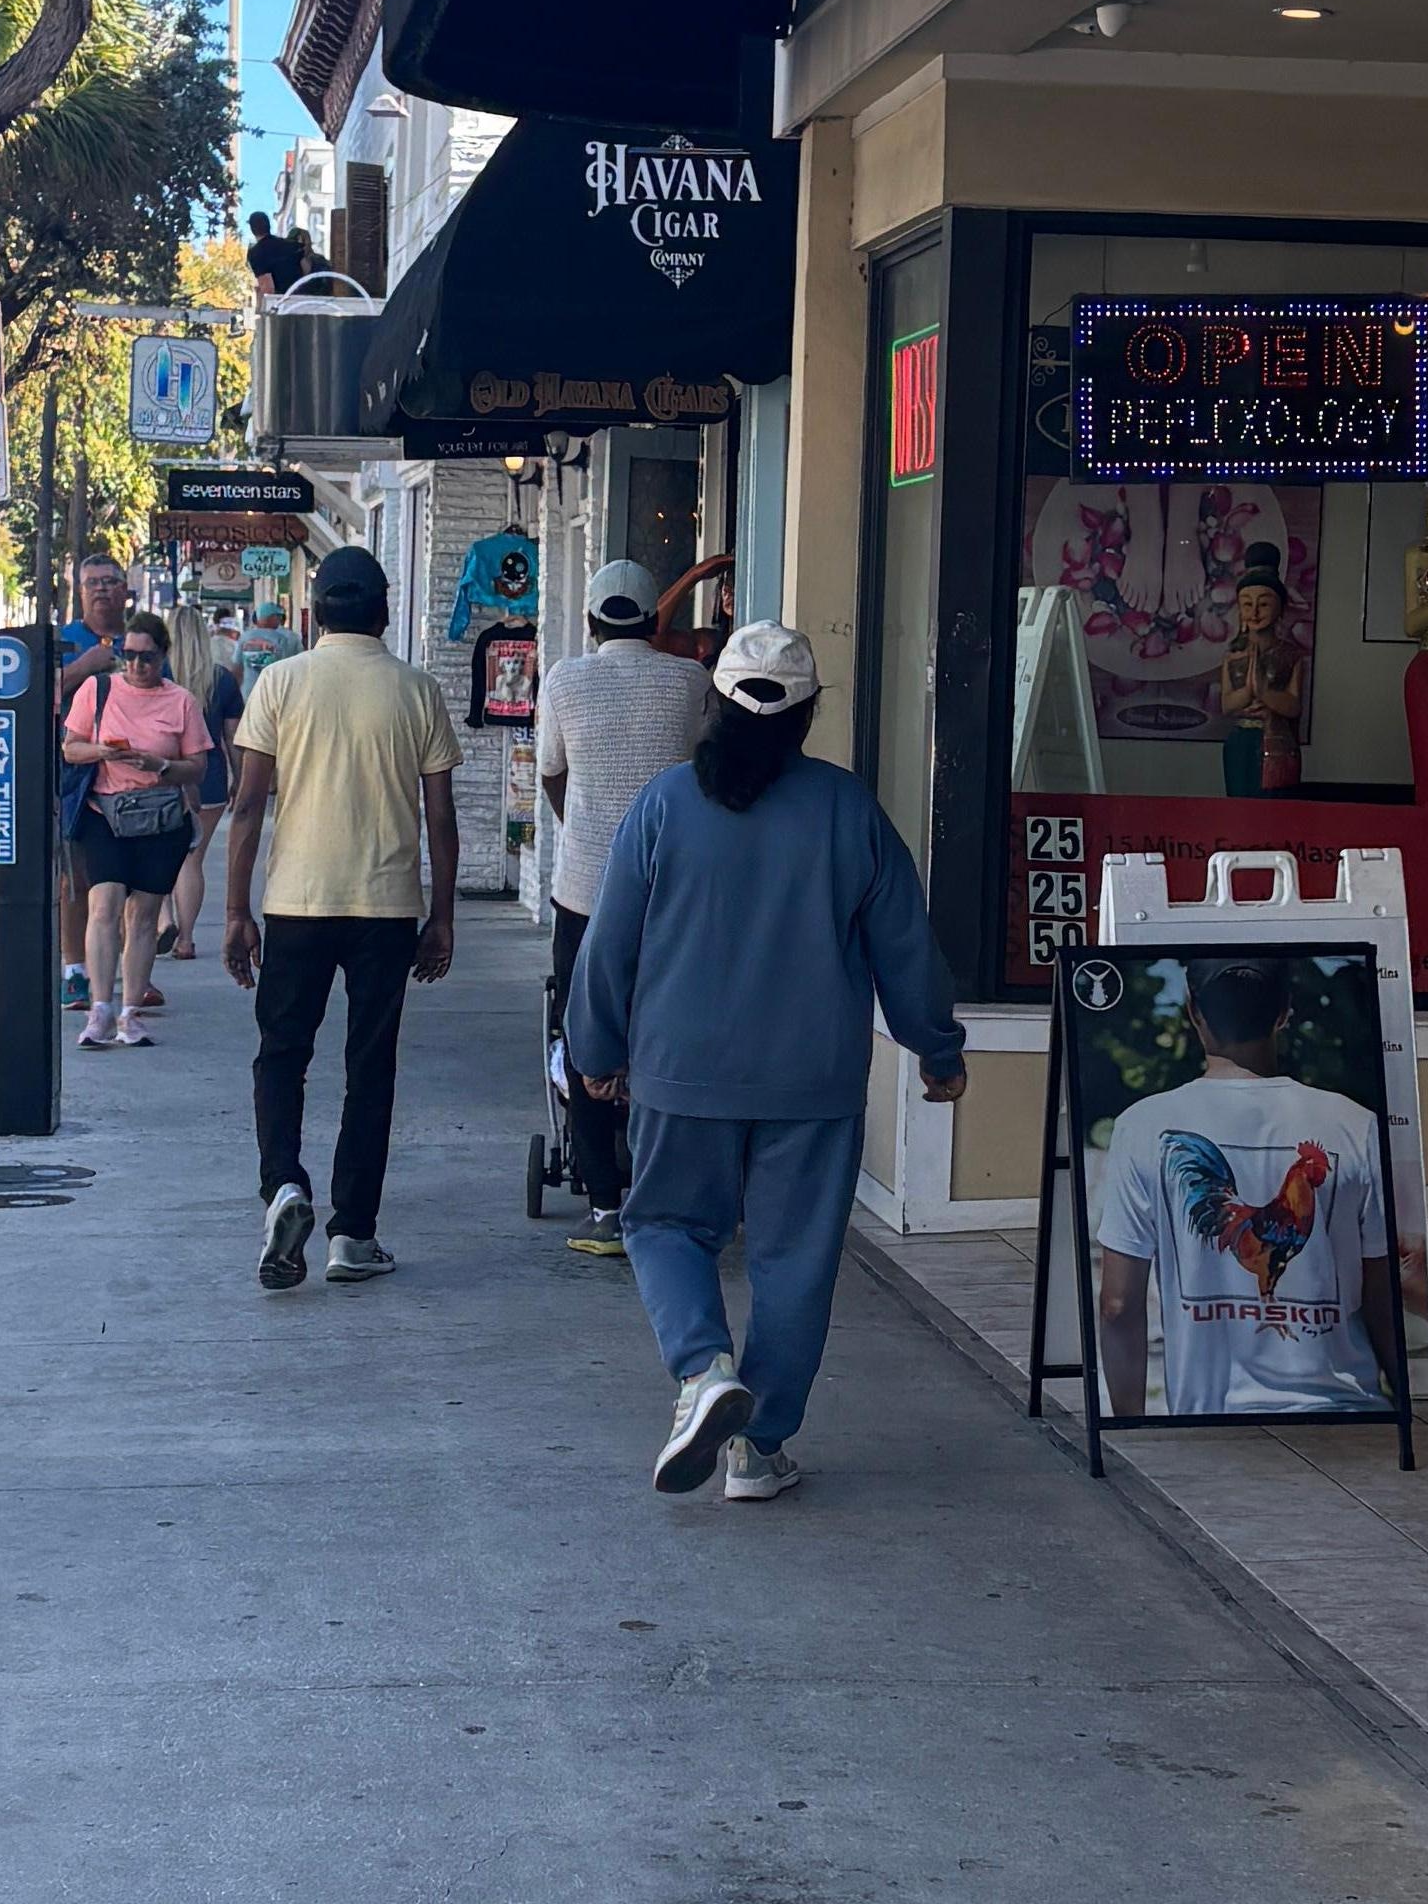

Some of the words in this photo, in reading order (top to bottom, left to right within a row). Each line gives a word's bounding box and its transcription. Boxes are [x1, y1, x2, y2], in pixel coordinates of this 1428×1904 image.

[585, 141, 763, 217] HAVANA
[629, 202, 720, 247] CIGAR
[649, 248, 706, 270] COMPANY
[1126, 324, 1383, 386] OPEN
[181, 483, 261, 499] seventeen
[262, 484, 302, 500] stars
[1030, 818, 1081, 860] 25
[1032, 872, 1084, 916] 25
[1034, 921, 1084, 964] 50
[1382, 1041, 1403, 1053] ins
[1182, 1302, 1341, 1325] UNASKIN
